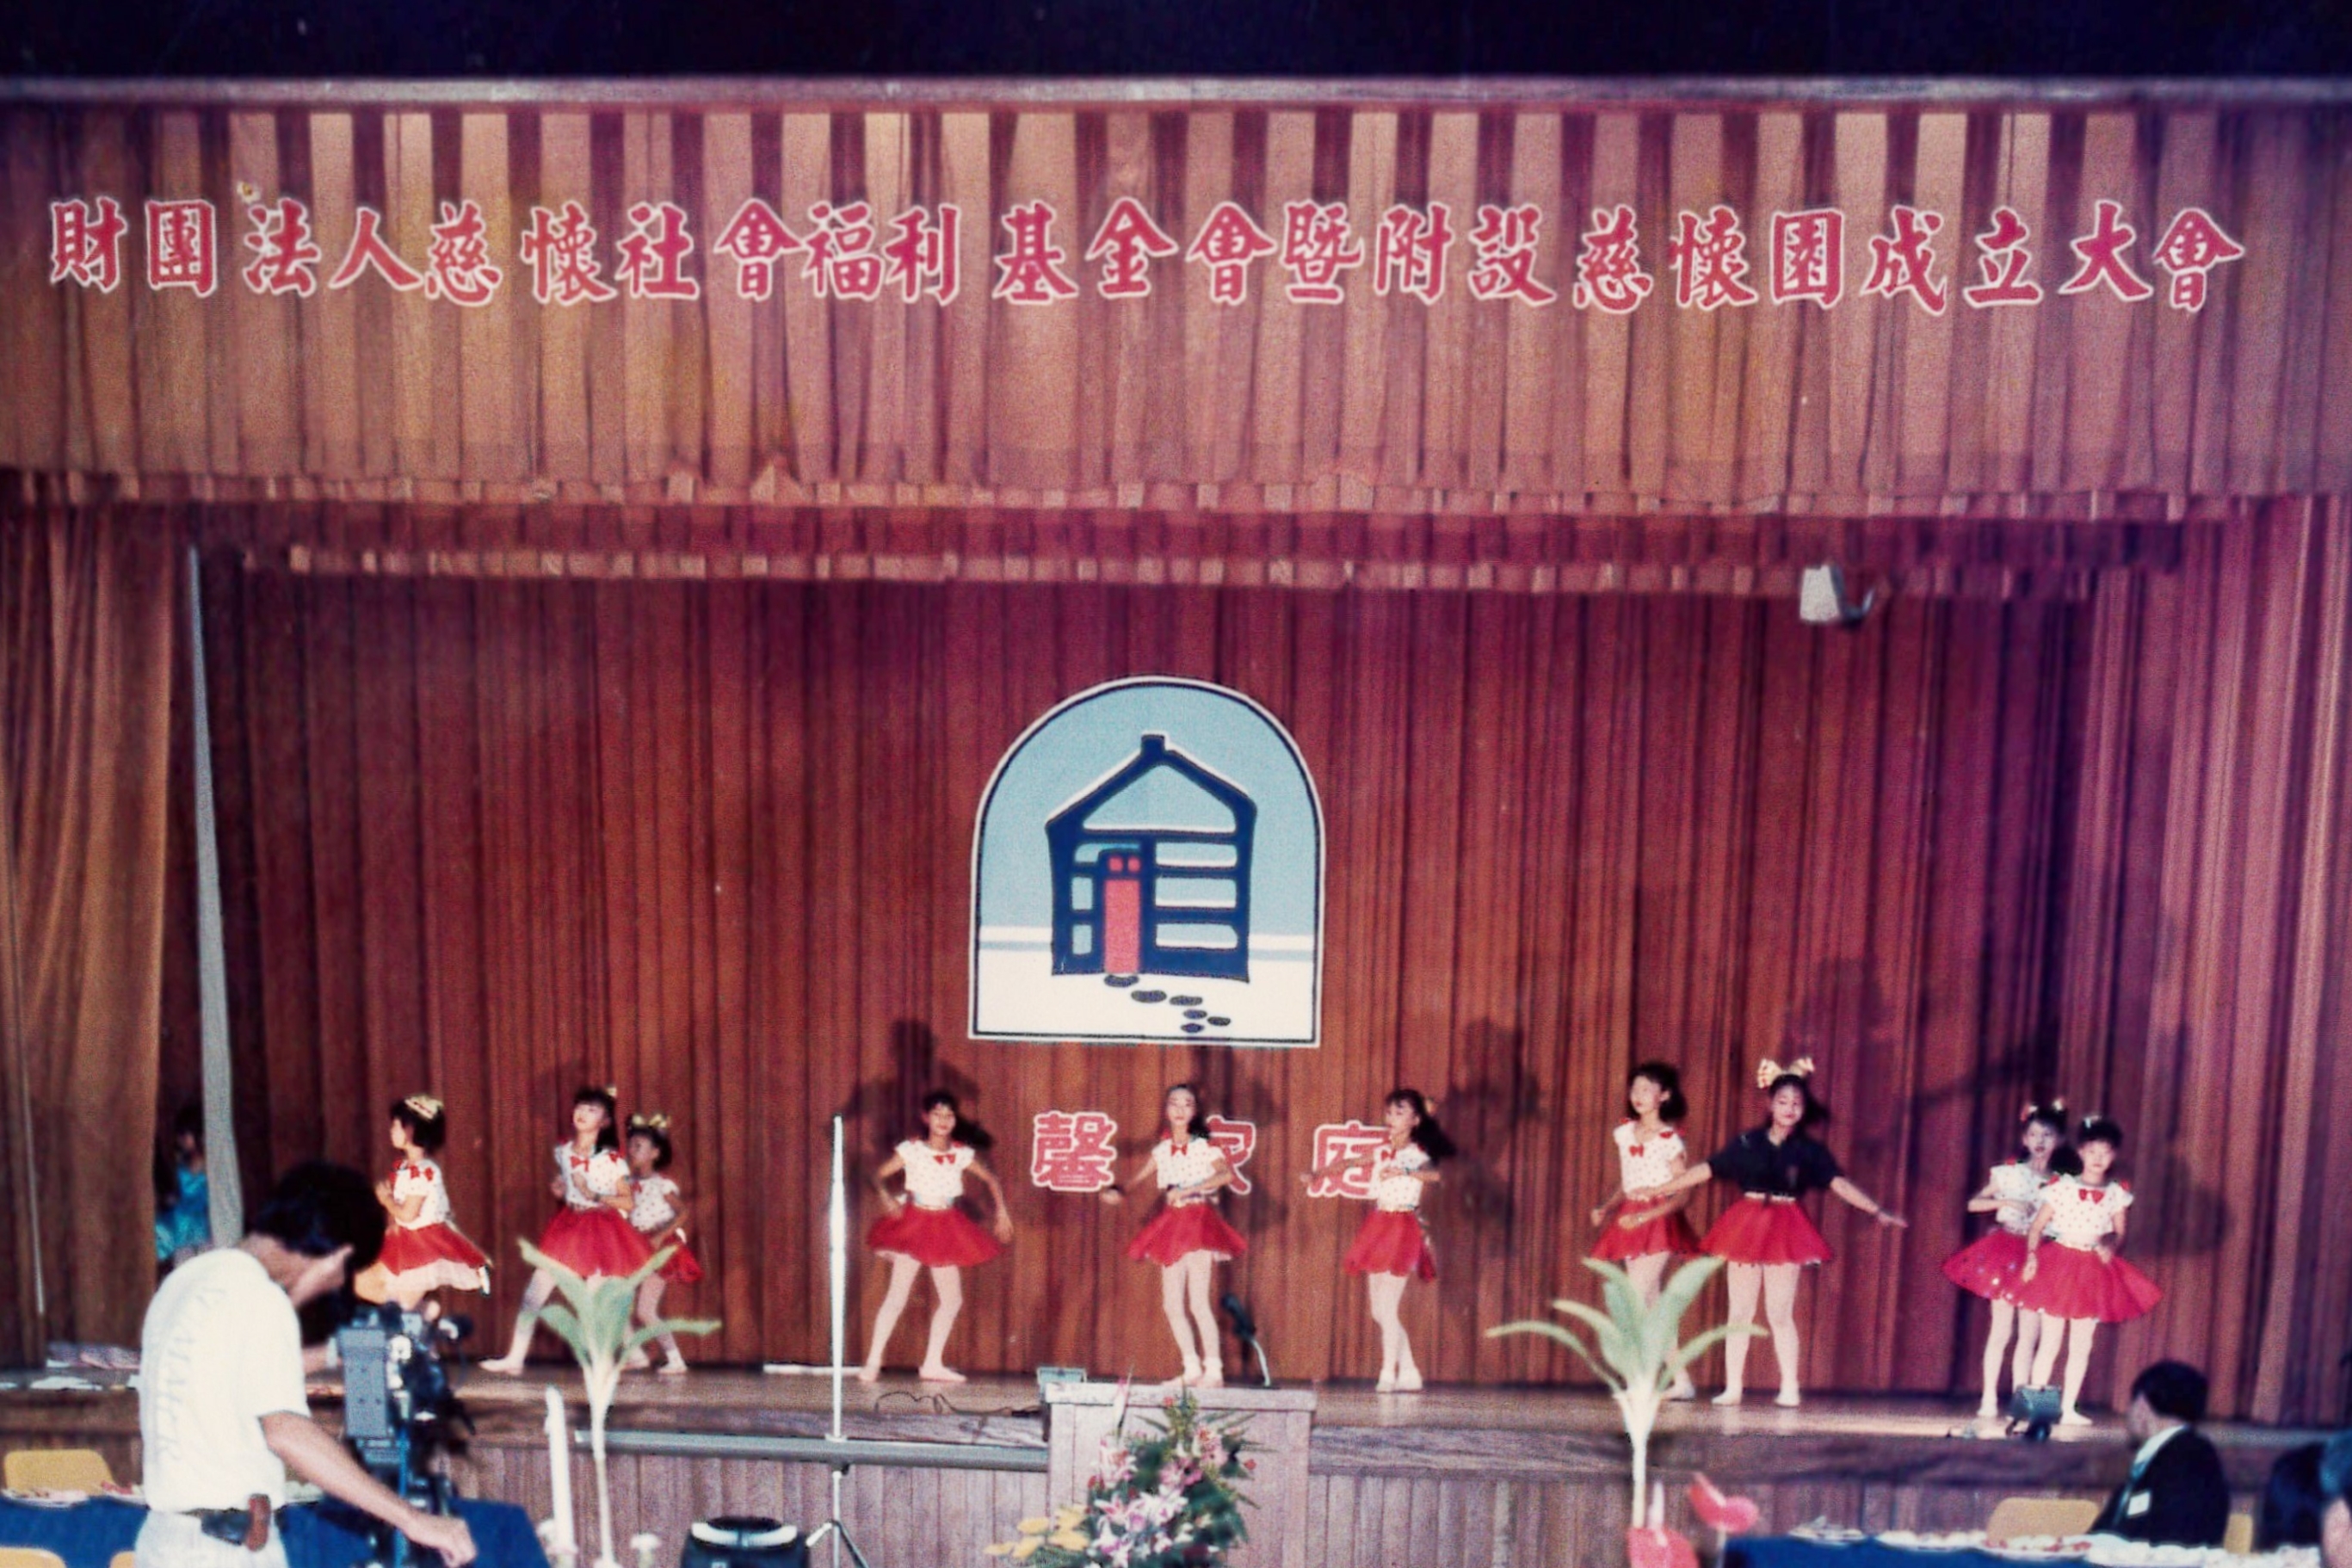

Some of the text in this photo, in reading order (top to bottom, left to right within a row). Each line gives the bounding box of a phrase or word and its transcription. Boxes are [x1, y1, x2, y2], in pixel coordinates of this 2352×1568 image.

[49, 195, 2244, 316] 財團法人慈懷社會福利基金會暨附設慈懷園成立大會
